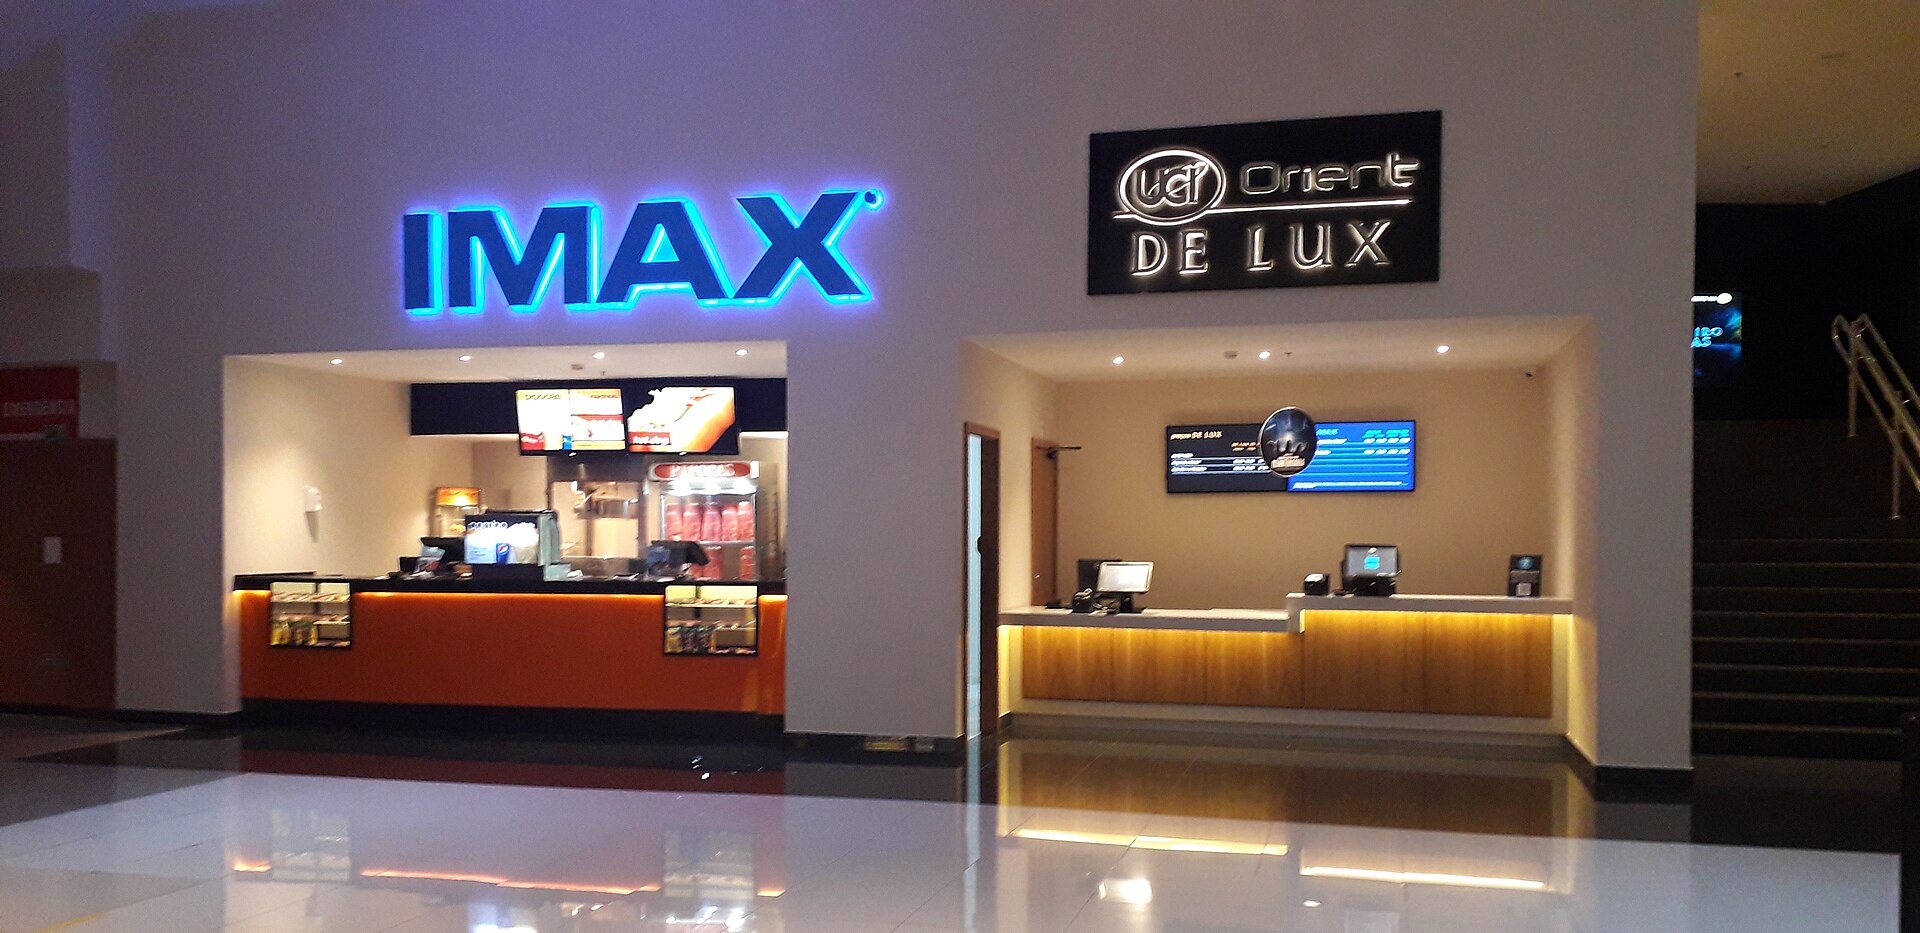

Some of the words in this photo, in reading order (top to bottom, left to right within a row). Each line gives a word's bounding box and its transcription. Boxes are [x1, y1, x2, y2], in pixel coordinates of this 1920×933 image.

[1239, 152, 1420, 196] Orient
[403, 189, 875, 315] IMAX
[1131, 227, 1209, 278] DE
[1245, 220, 1393, 272] LUX
